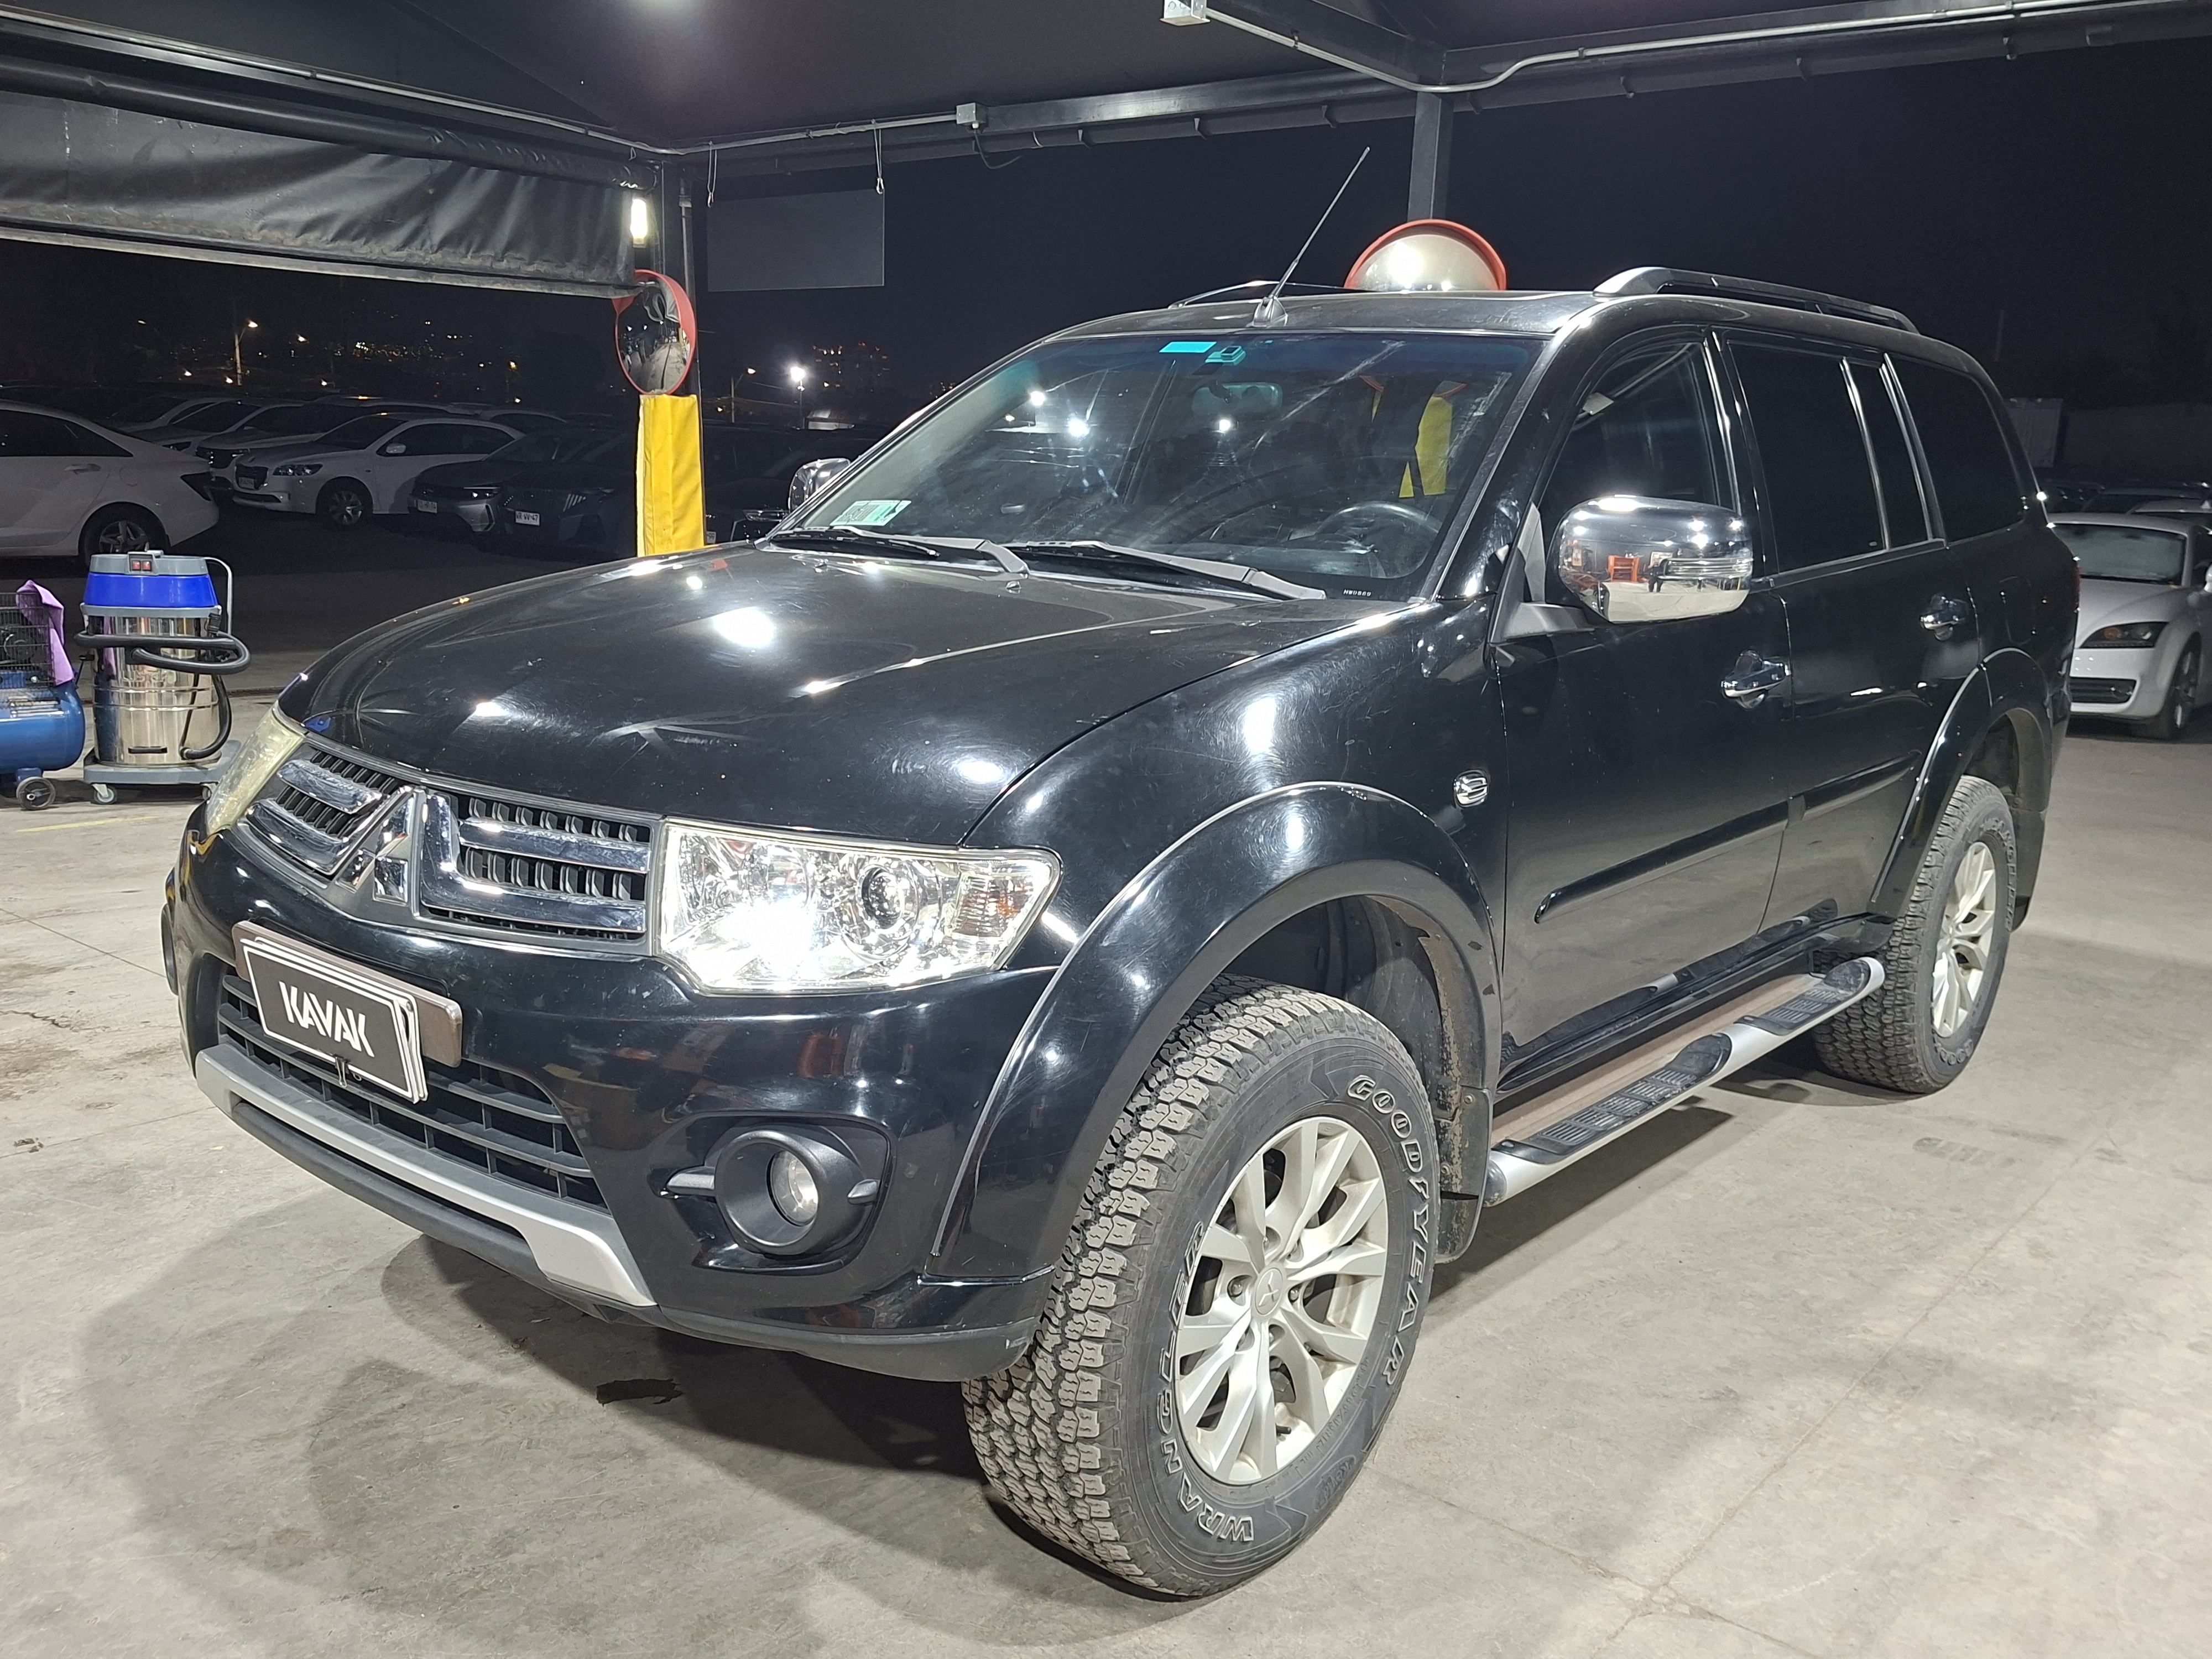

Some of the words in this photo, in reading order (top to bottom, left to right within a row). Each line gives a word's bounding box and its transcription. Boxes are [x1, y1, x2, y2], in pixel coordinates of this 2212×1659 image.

[278, 980, 375, 1058] KAVAK
[1156, 1220, 1254, 1542] WRANGLER
[1347, 1074, 1430, 1385] GOODYEAR
